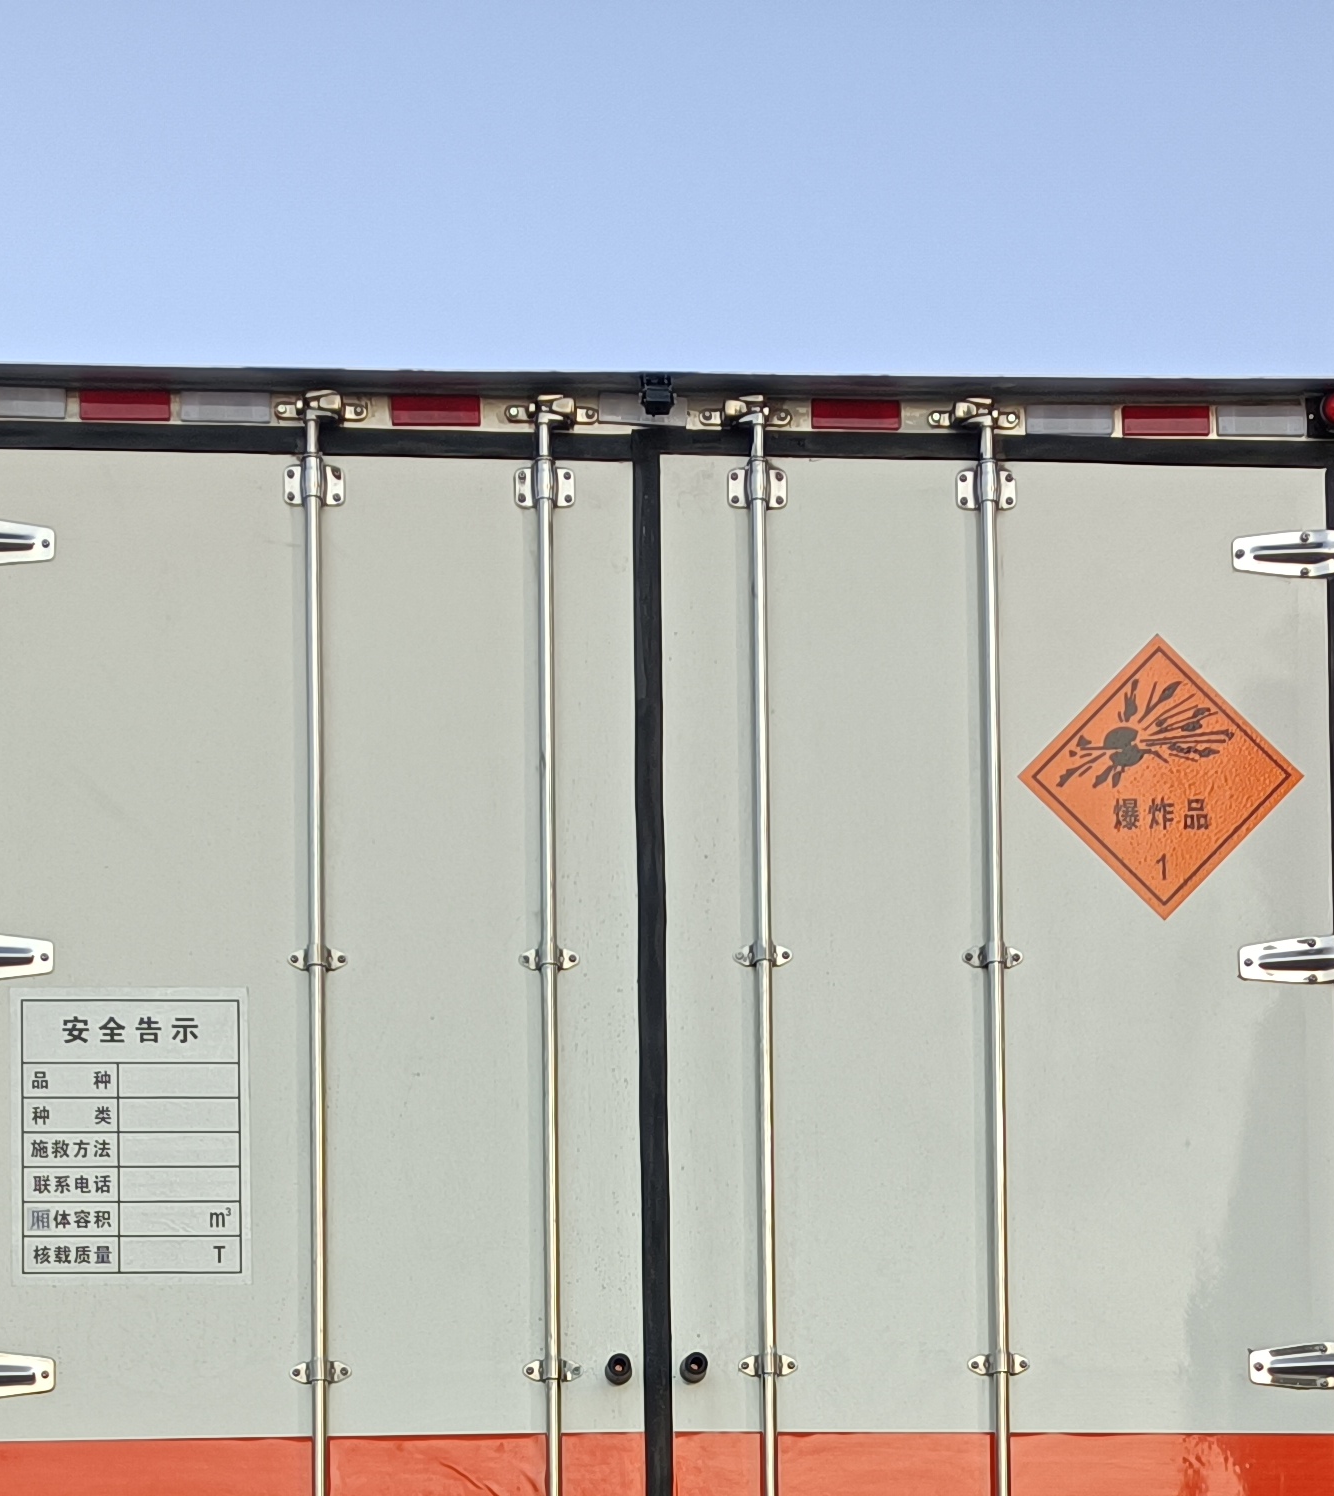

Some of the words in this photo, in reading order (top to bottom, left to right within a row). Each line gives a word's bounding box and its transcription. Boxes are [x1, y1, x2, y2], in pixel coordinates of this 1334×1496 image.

[1113, 797, 1209, 830] 爆炸品
[1155, 853, 1167, 880] 1
[62, 1016, 199, 1044] 安全告示
[30, 1139, 112, 1158] 施救方法
[33, 1175, 112, 1194] 联系电话
[33, 1245, 112, 1264] 核载质量
[213, 1245, 226, 1264] T
